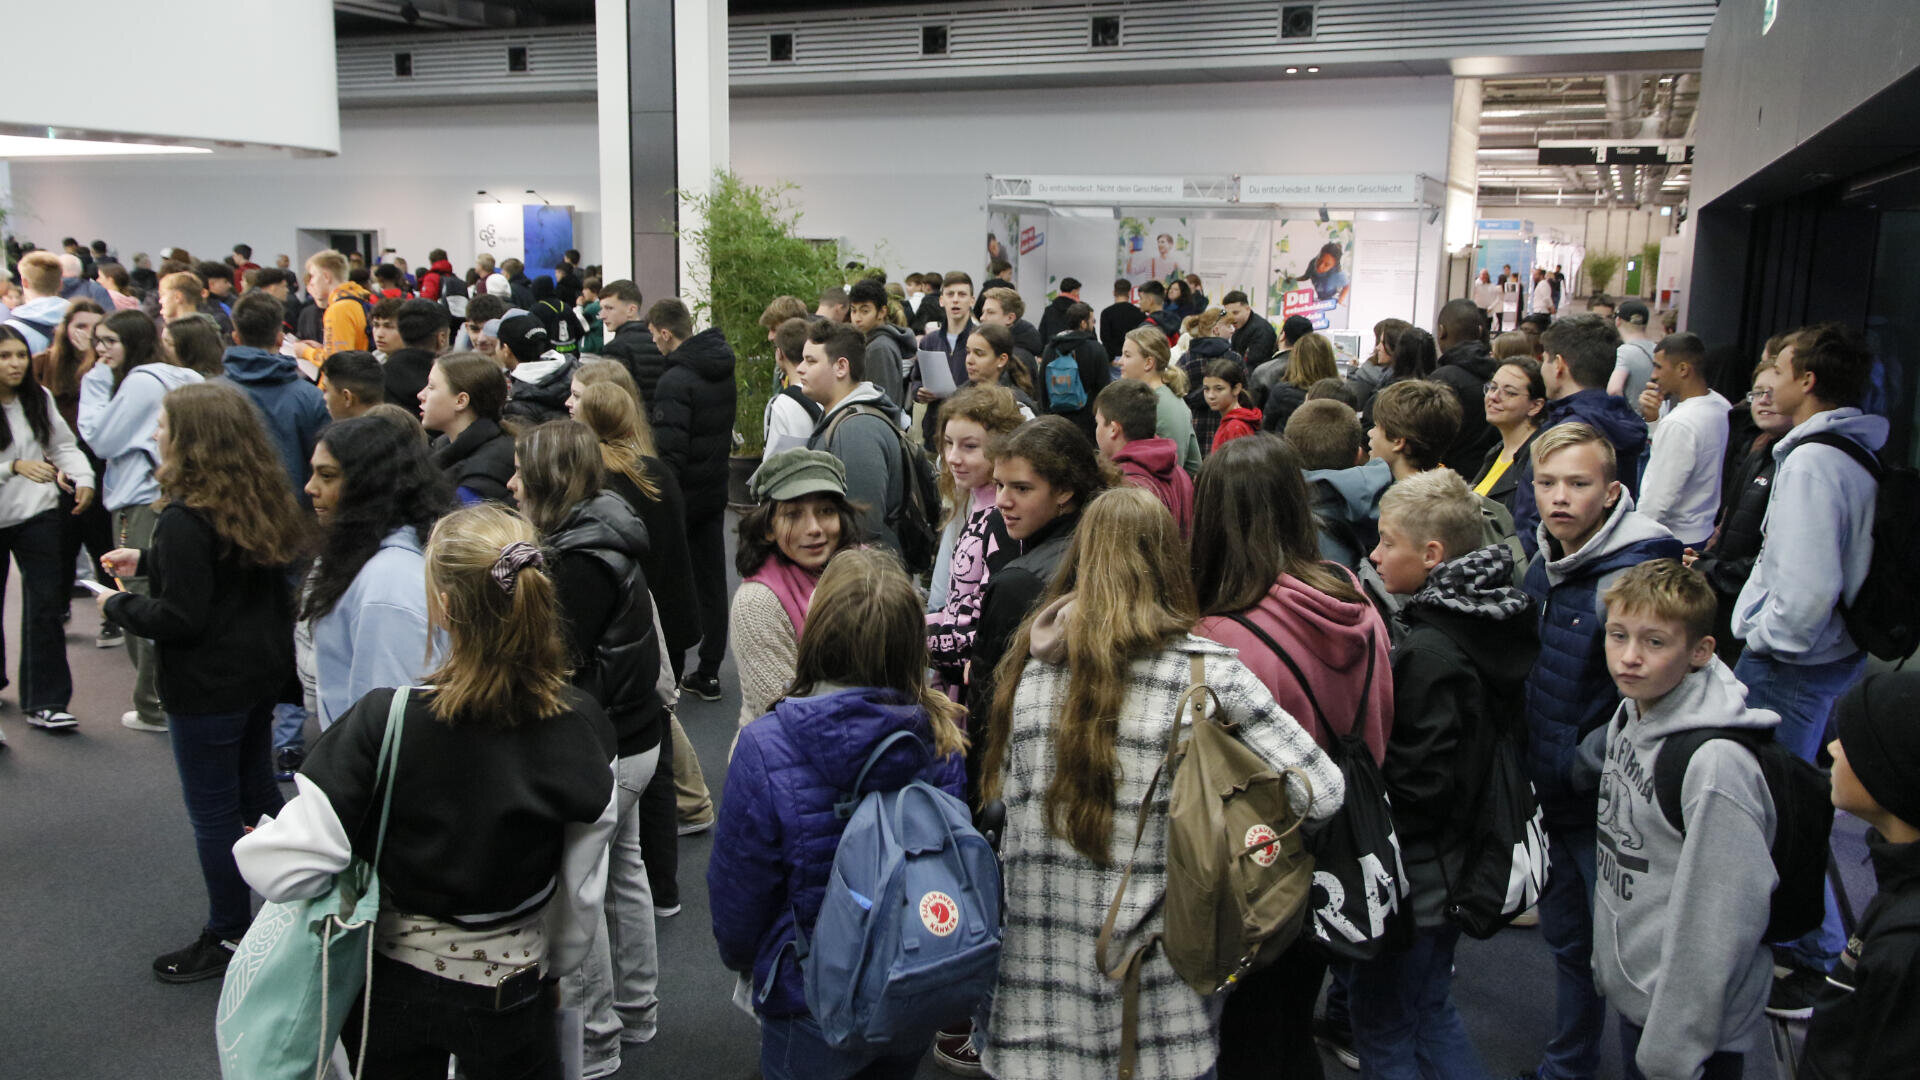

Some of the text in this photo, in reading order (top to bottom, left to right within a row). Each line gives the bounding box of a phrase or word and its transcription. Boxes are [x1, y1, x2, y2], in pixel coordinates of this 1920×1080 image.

[1038, 184, 1174, 193] Du entscheidest. Nicht dein Geschlecht.
[1249, 183, 1403, 194] Du entscheidest. Nicht dein Geschlecht.
[1286, 292, 1310, 306] Du
